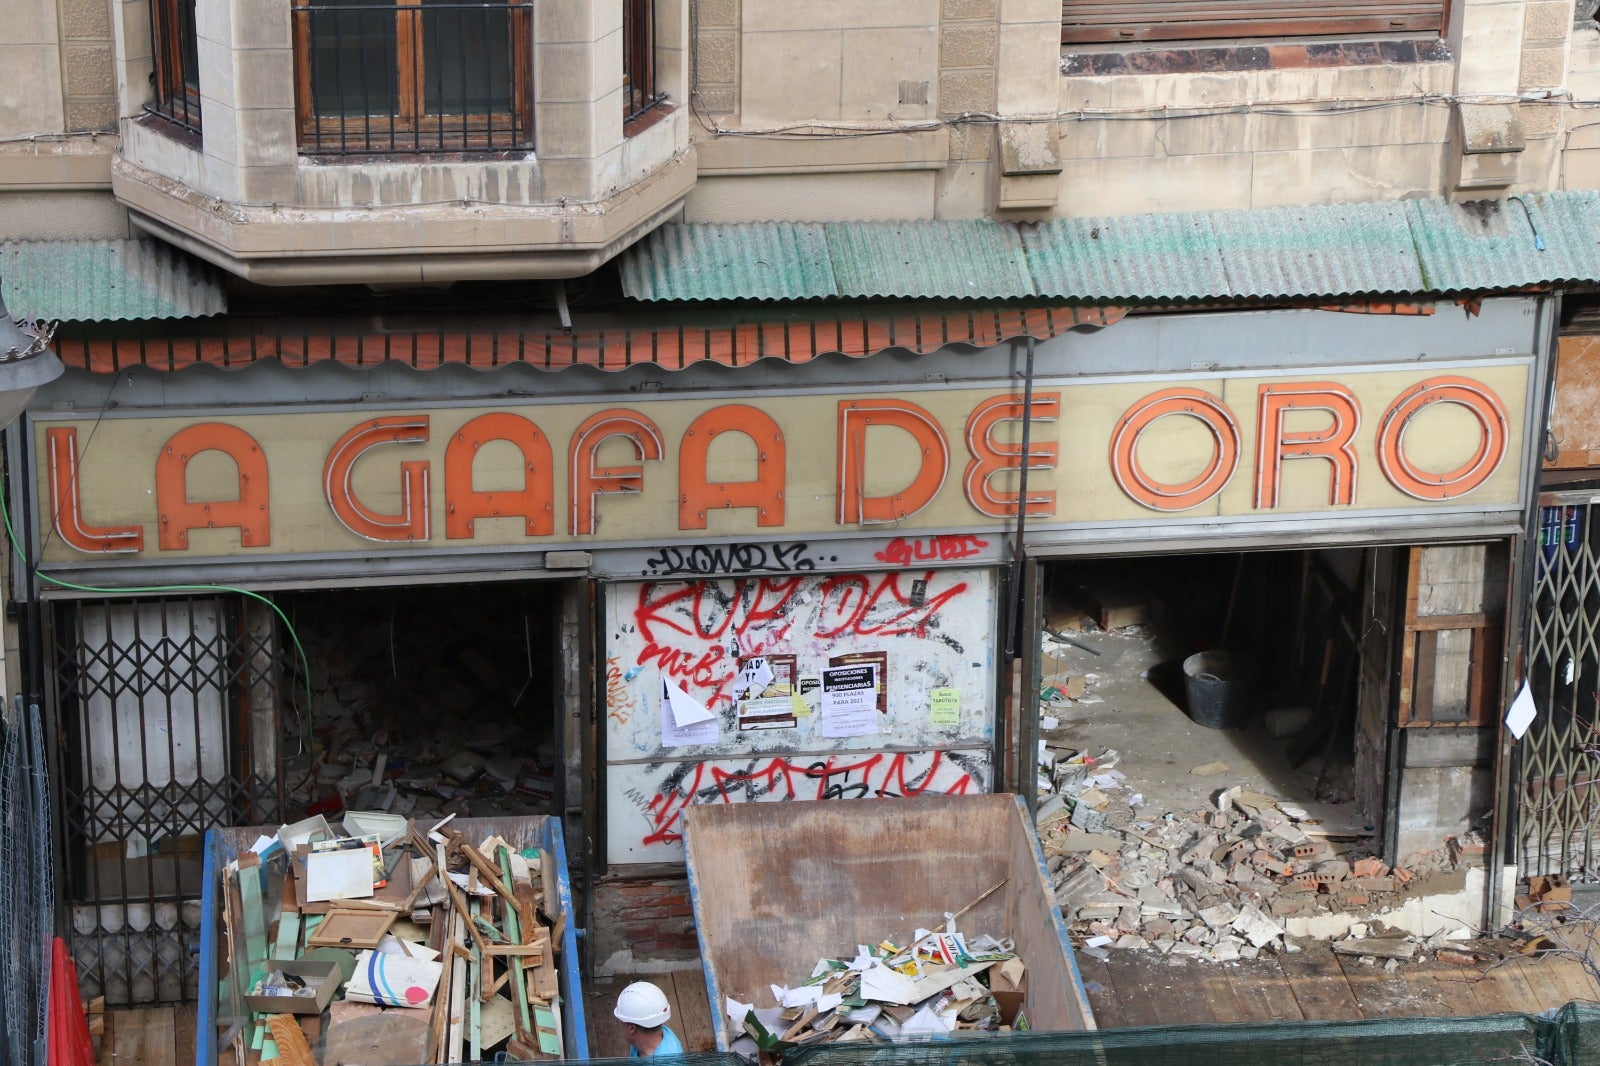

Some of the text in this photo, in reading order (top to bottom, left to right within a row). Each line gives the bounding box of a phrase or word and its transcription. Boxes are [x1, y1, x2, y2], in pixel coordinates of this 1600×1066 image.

[46, 375, 1511, 553] LA GAFA DE ORO
[829, 668, 868, 677] OPOSICIONES
[843, 690, 865, 698] PLAZAS
